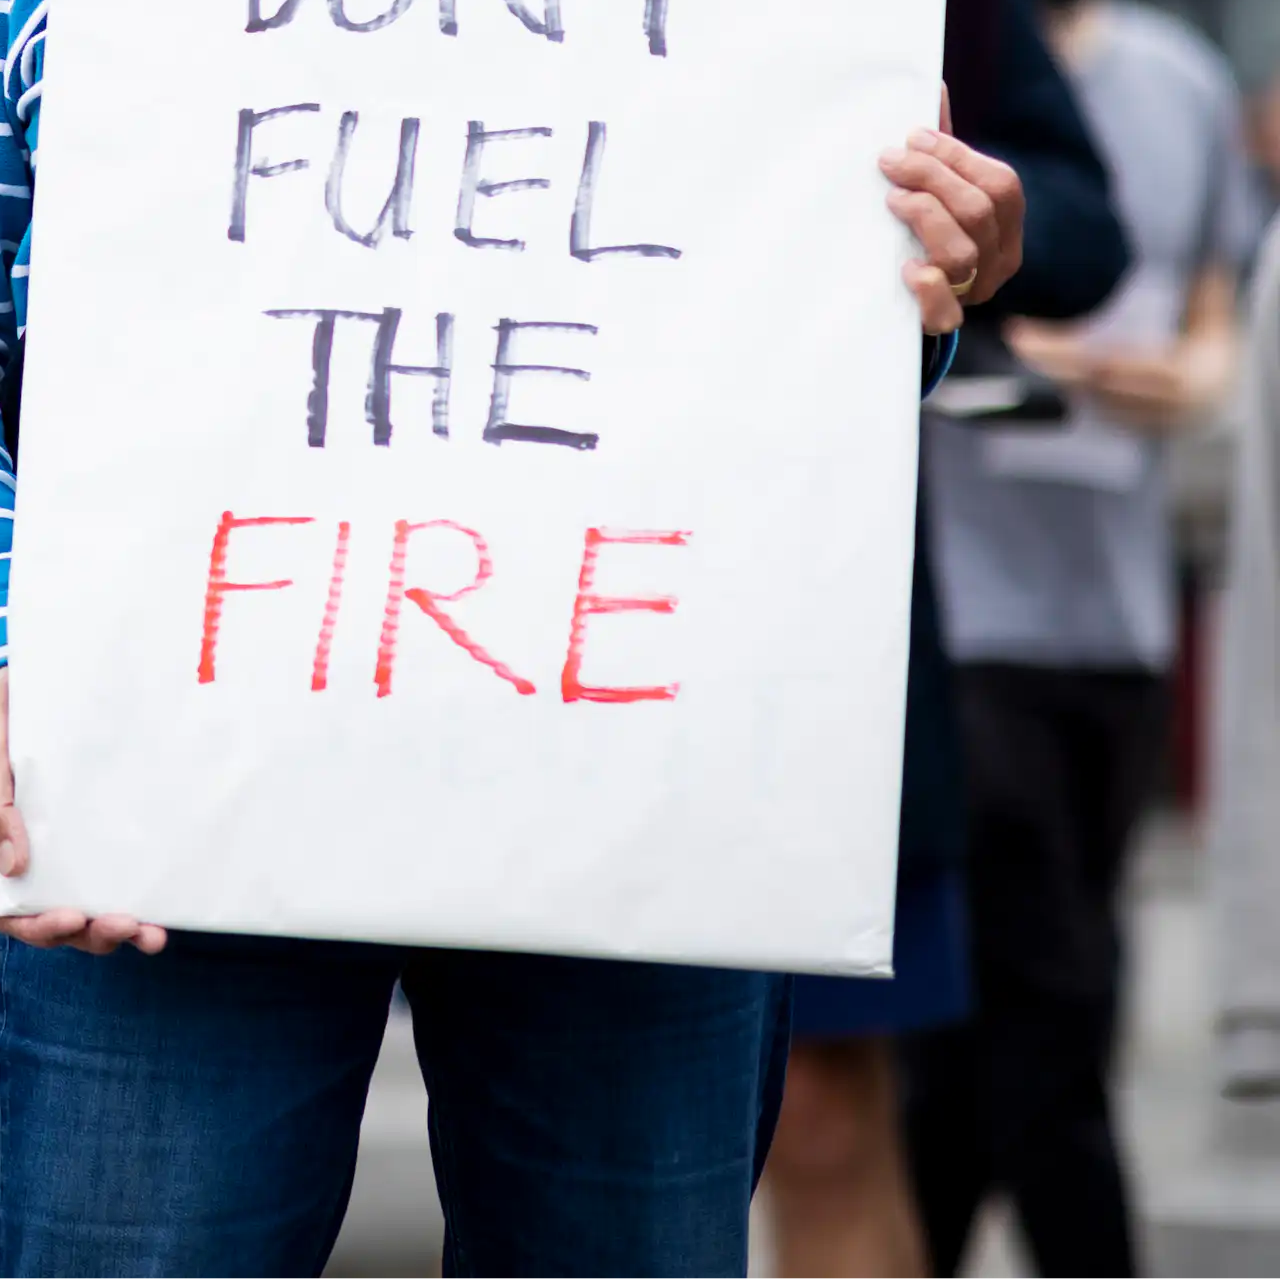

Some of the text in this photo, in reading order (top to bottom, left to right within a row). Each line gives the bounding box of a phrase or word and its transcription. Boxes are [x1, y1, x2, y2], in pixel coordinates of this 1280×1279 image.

[227, 102, 683, 264] FUEL
[263, 306, 600, 451] THE
[197, 510, 693, 704] FIRE
